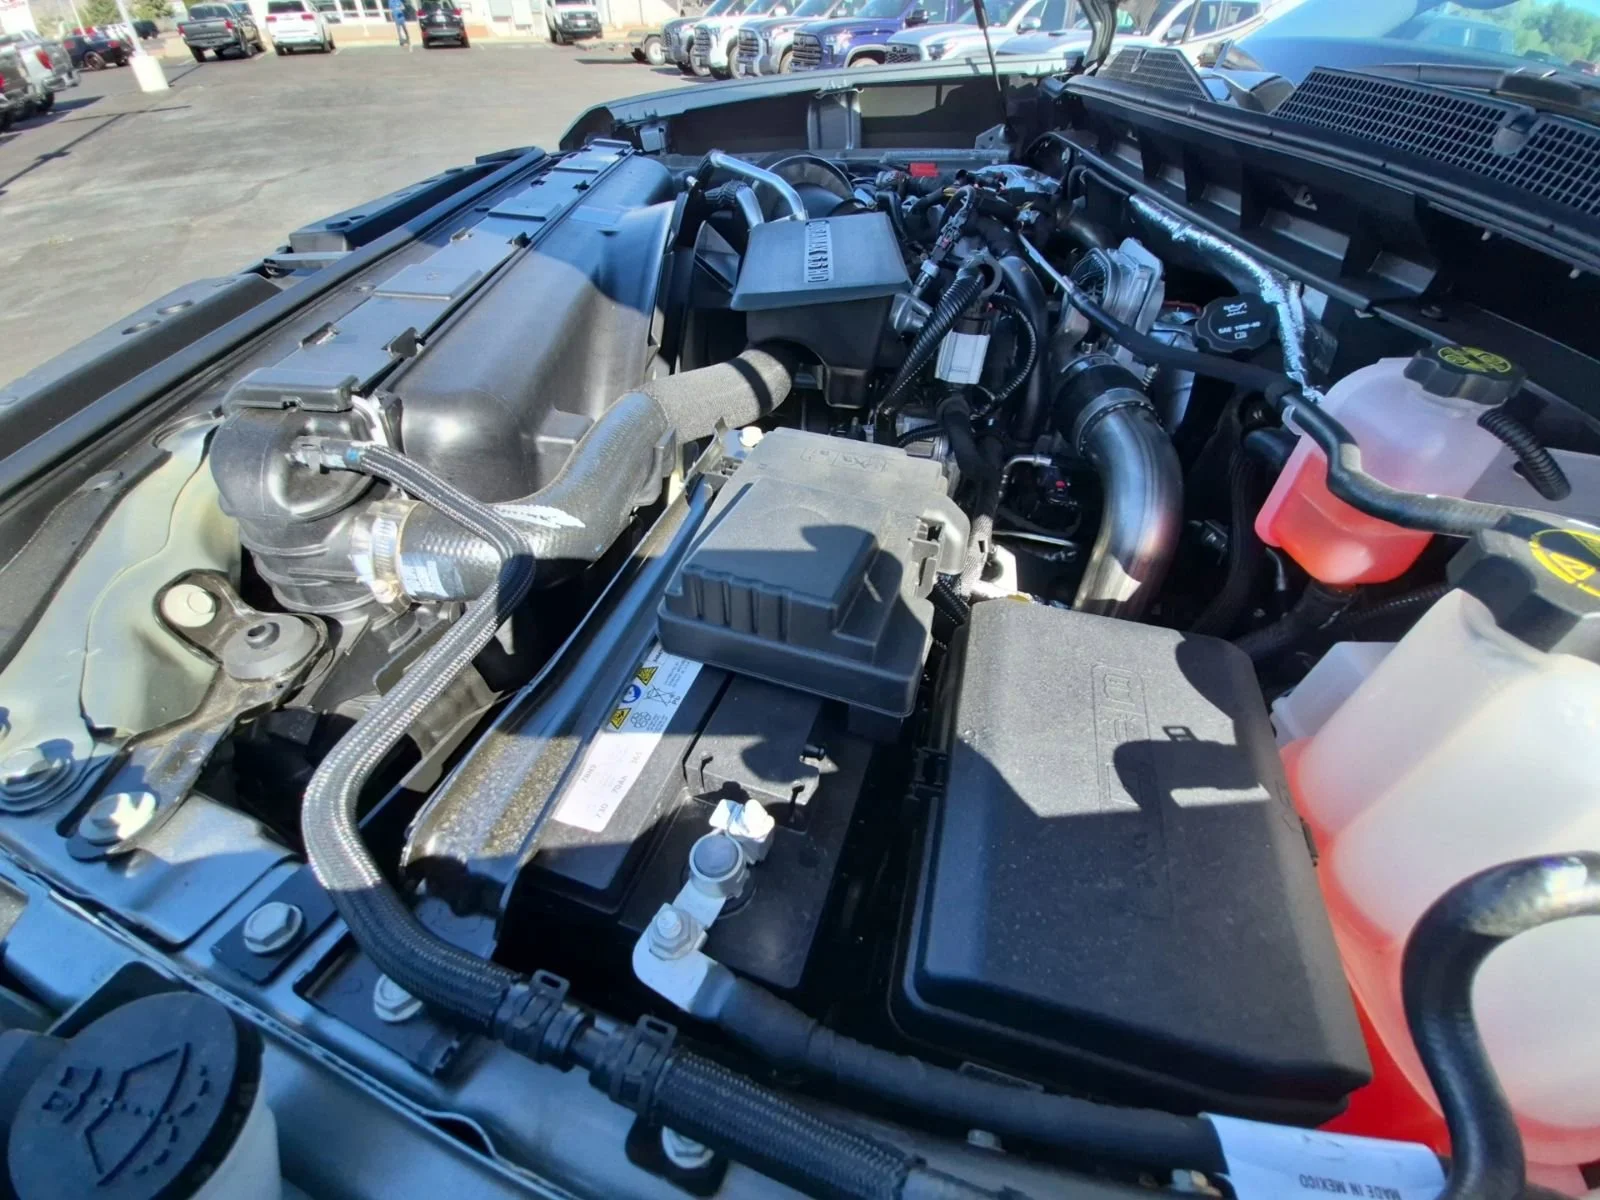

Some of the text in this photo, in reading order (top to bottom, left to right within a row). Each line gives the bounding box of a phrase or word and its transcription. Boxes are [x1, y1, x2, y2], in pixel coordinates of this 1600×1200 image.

[1299, 1174, 1401, 1200] MADE IN MEXICO
